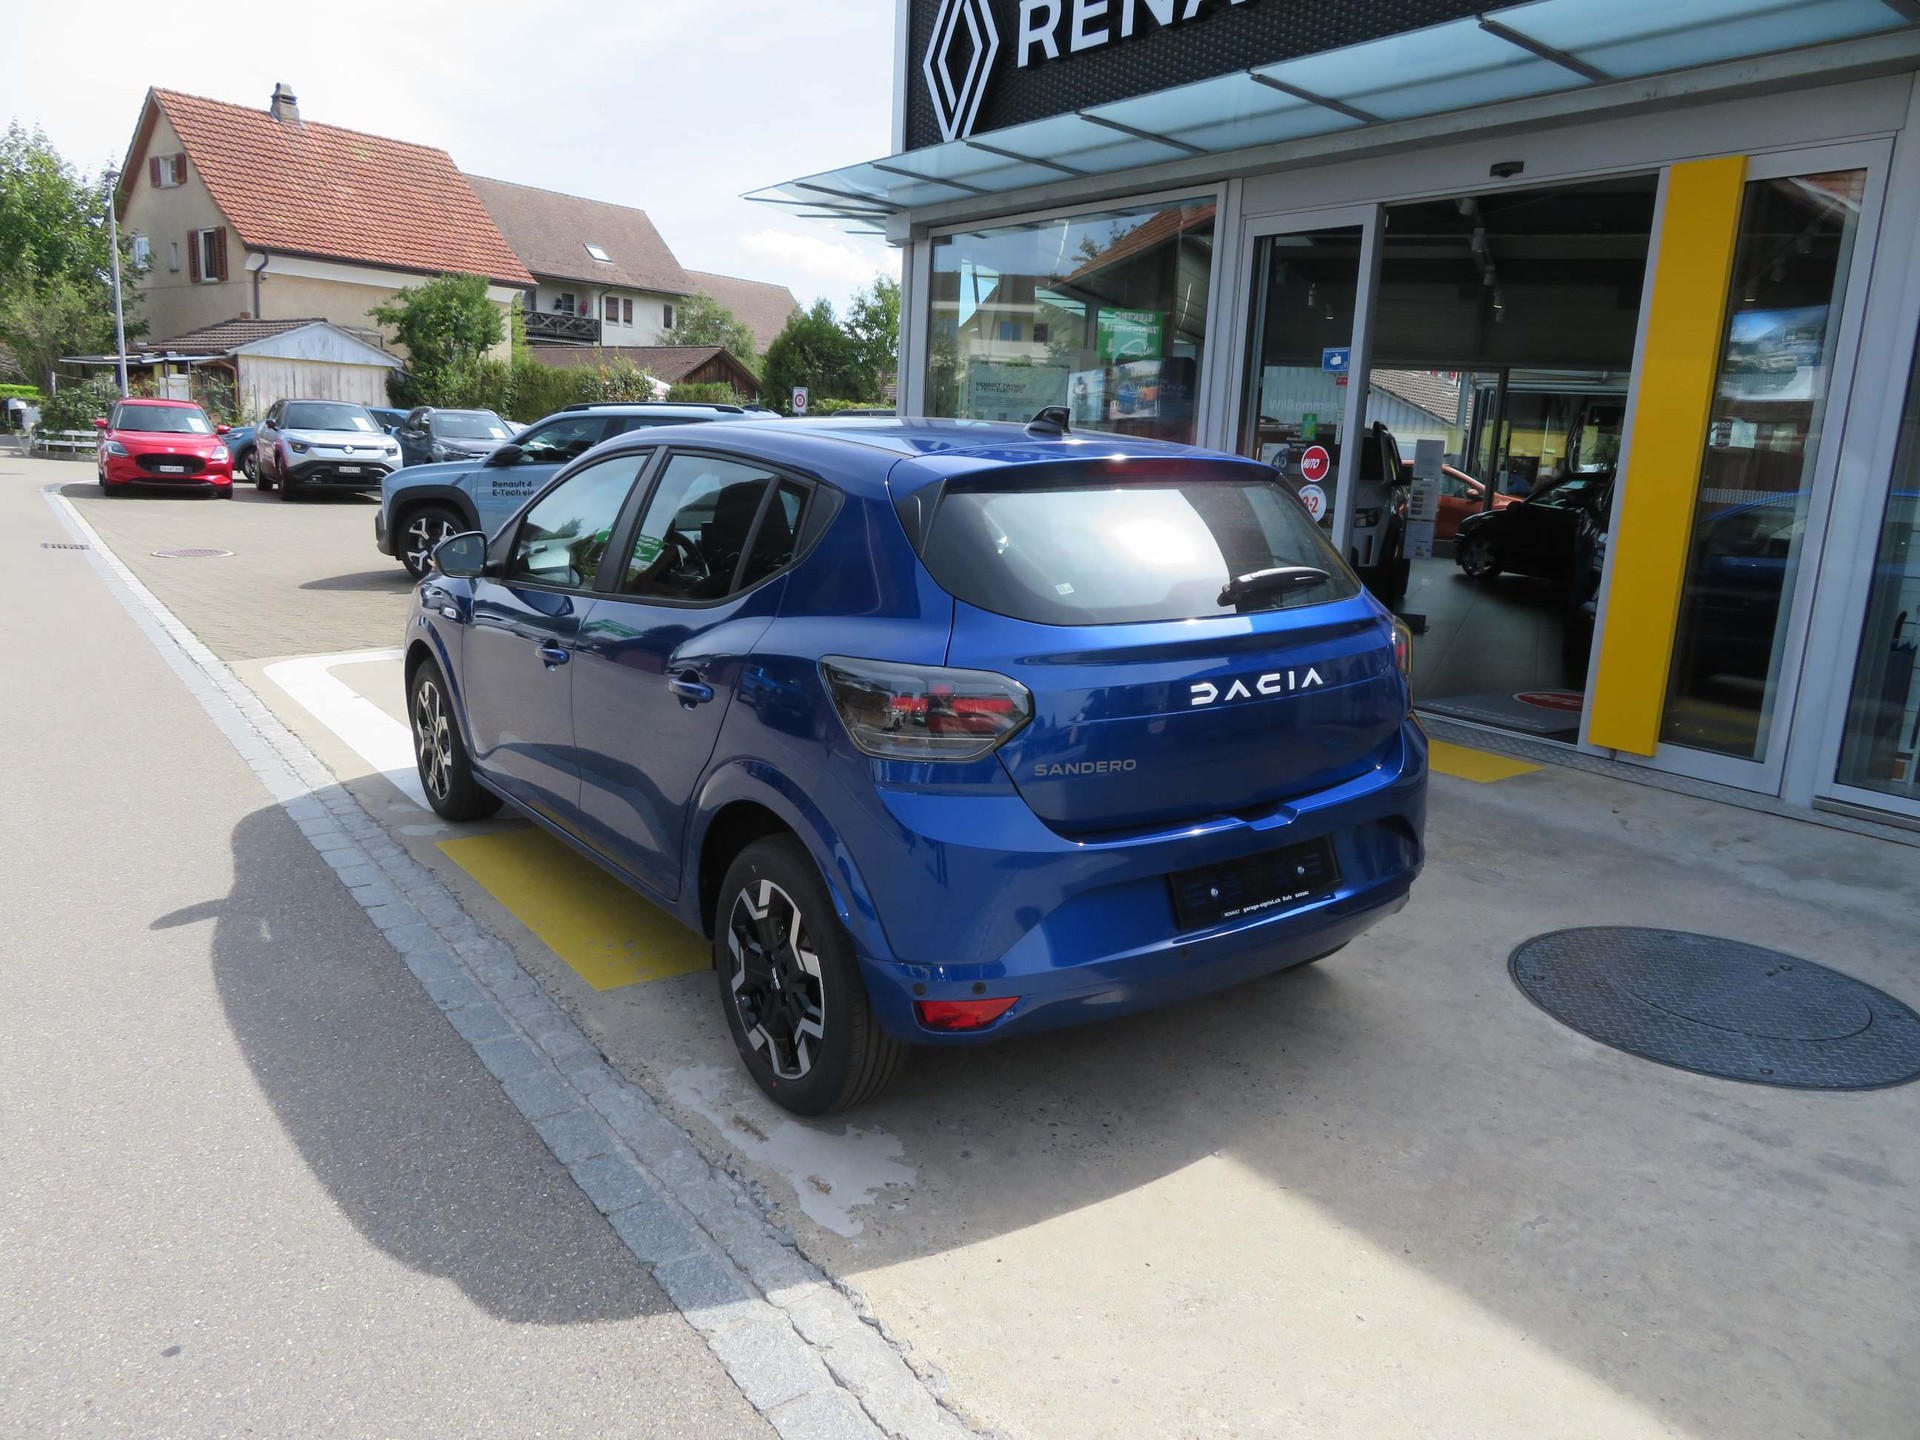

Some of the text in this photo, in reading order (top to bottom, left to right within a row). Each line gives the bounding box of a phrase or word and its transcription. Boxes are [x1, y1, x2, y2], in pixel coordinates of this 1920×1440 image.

[1269, 400, 1337, 411] Willkommen
[492, 489, 521, 497] E-Tech
[1190, 667, 1323, 706] DACIA
[1033, 759, 1137, 777] SANDERO
